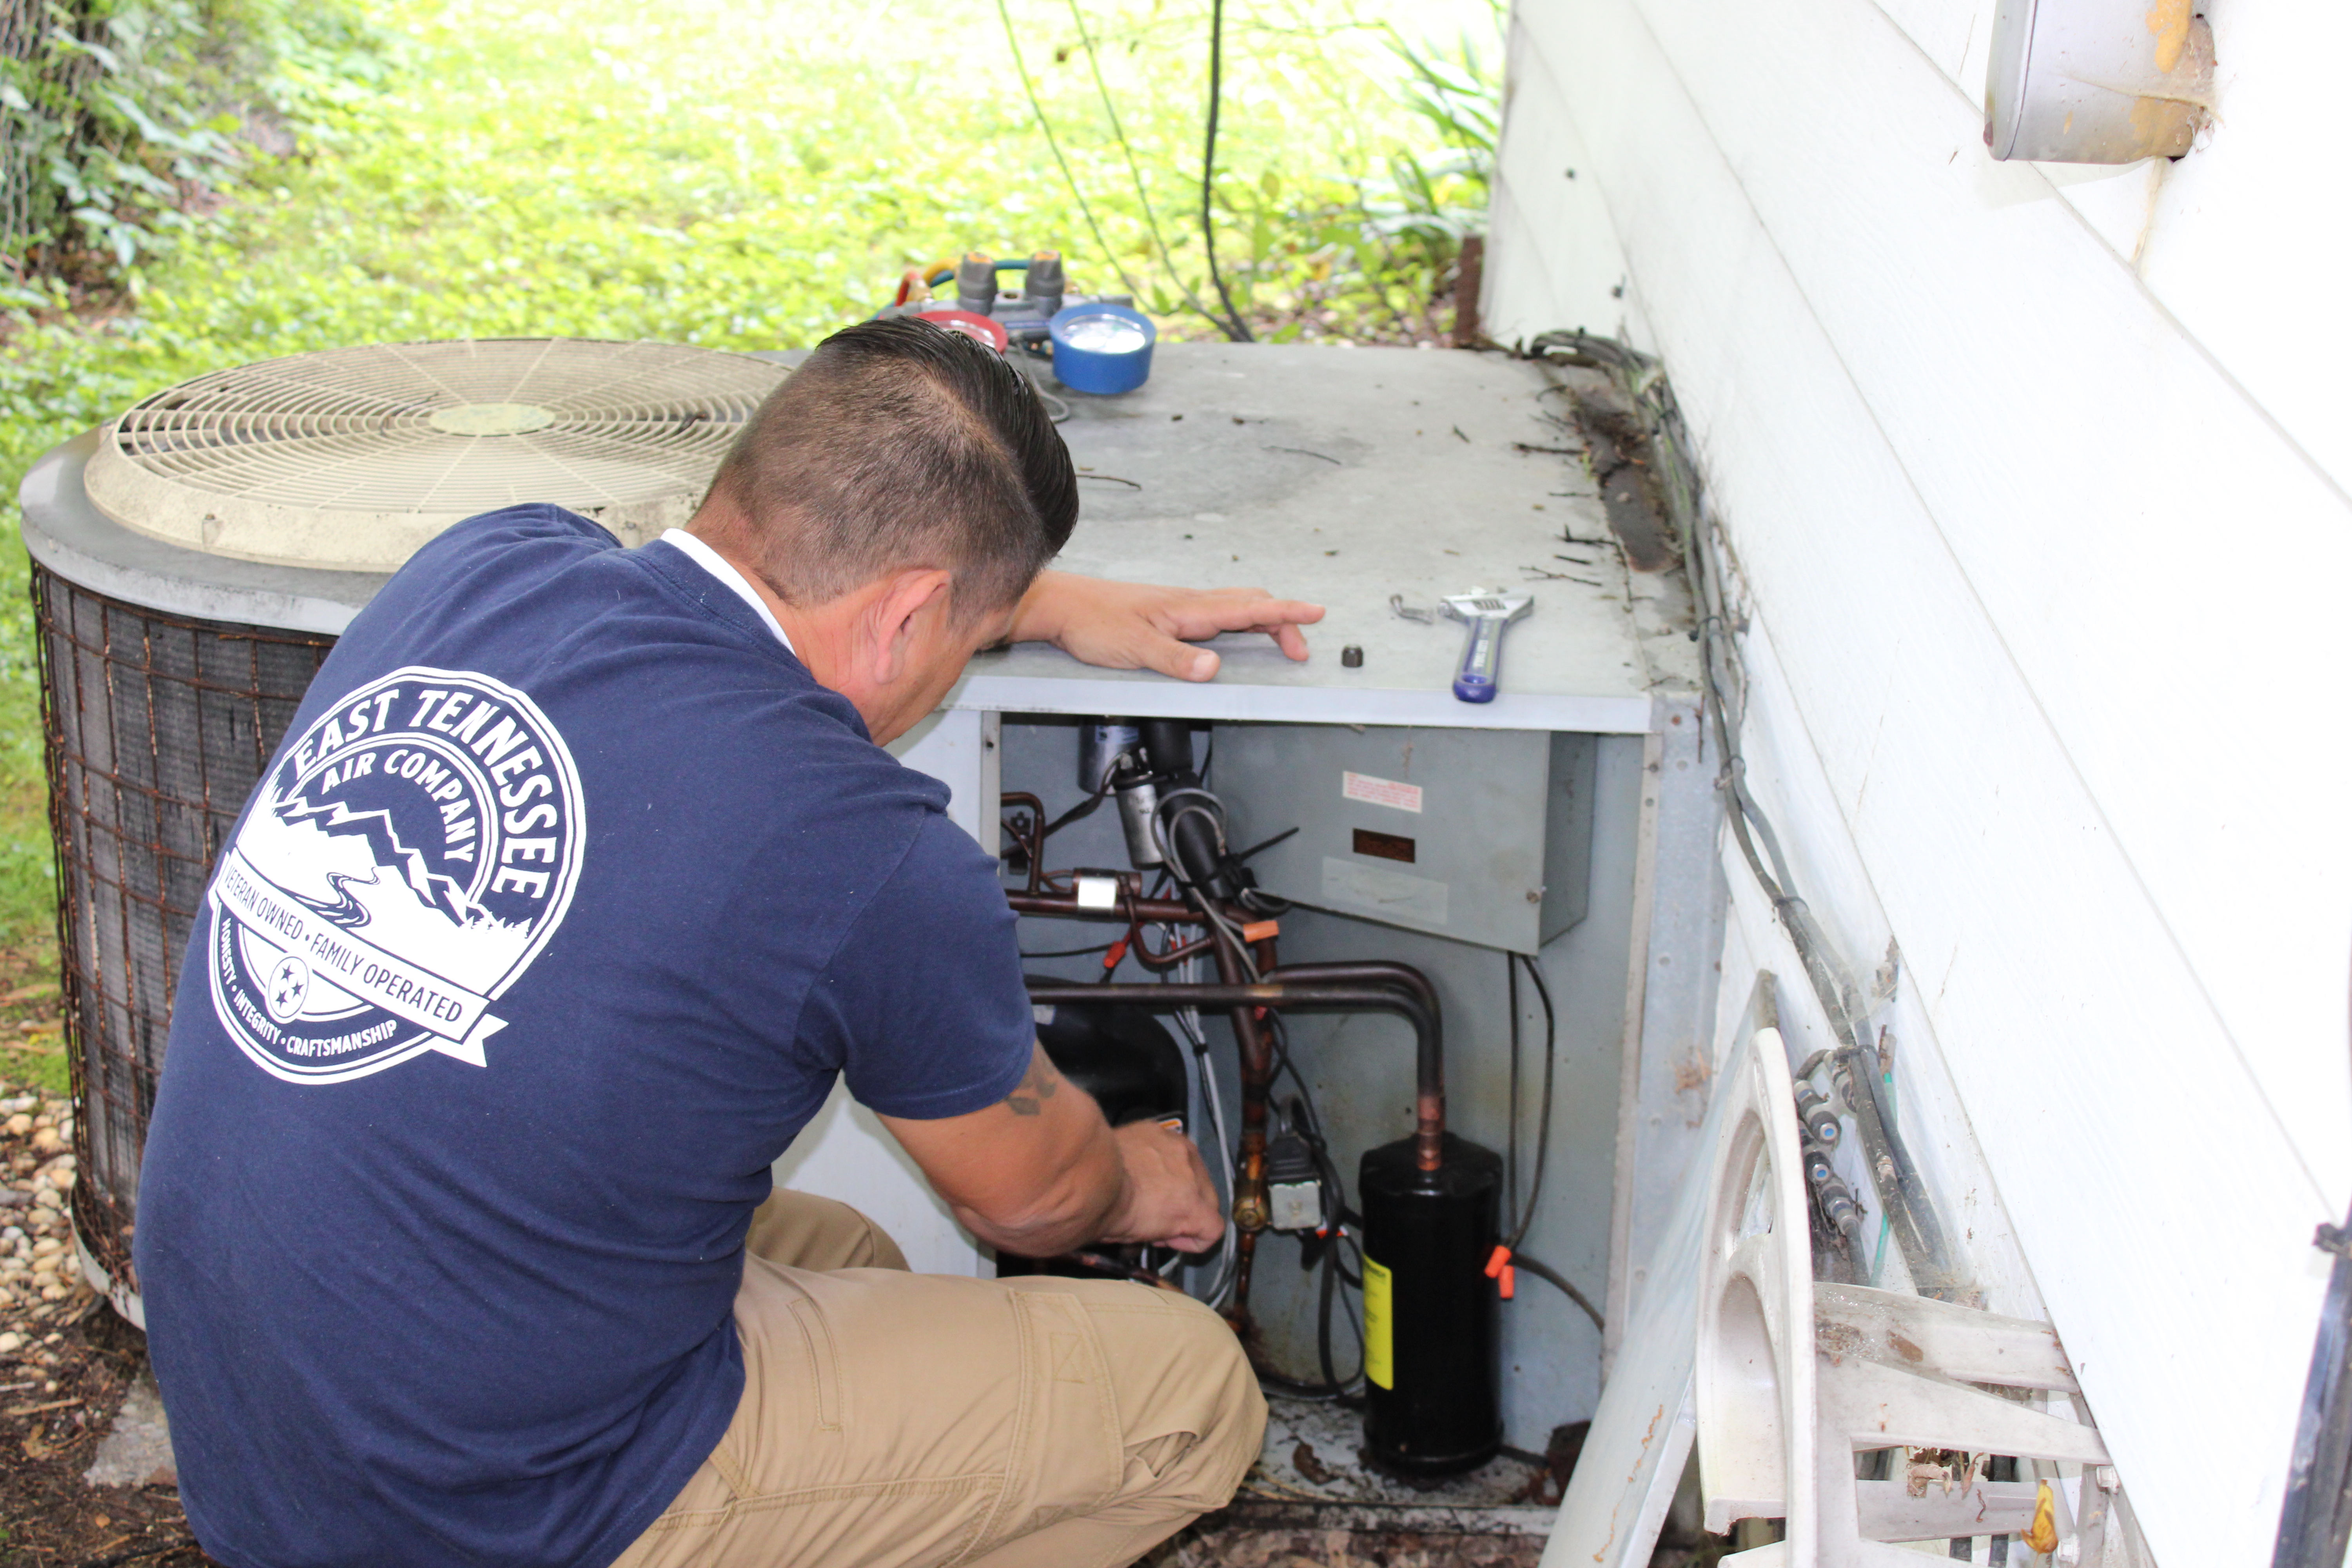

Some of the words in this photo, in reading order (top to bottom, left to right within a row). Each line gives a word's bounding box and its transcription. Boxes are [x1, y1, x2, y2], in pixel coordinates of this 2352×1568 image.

[293, 689, 400, 780] EAST
[408, 690, 558, 898] TENNESSEE
[321, 752, 376, 794] AIR
[385, 749, 475, 862] COMPANY
[221, 918, 237, 985] HONESTY
[234, 989, 281, 1045] INTEGRITY
[286, 1020, 397, 1057] CRAFTSMANSHIP
[224, 864, 260, 912] VETERAN
[257, 897, 303, 940] OWNED
[310, 933, 365, 976] FAMILY
[363, 964, 462, 1022] OPERATED
